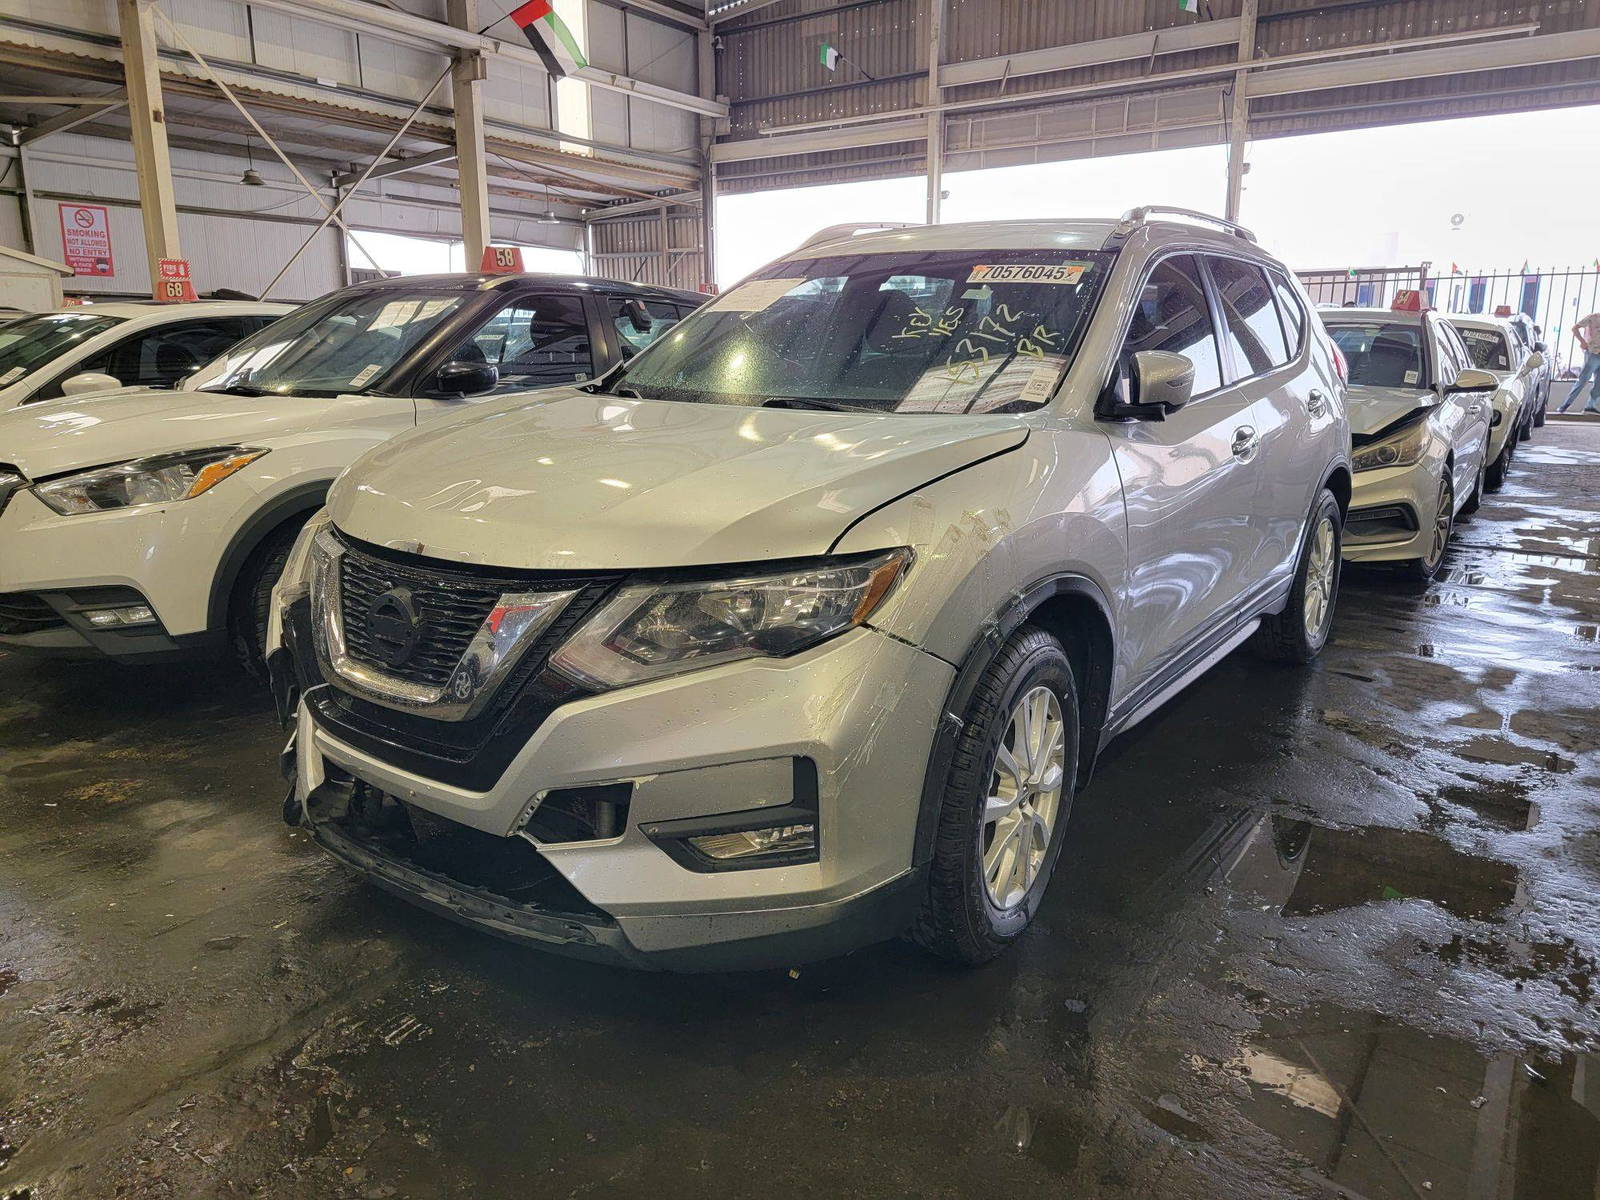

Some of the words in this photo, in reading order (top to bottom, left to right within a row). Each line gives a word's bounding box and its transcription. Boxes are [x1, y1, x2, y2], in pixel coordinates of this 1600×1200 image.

[67, 229, 105, 238] SMOKING
[81, 239, 107, 247] ALLOWED
[496, 248, 515, 267] 58
[167, 282, 183, 297] 68
